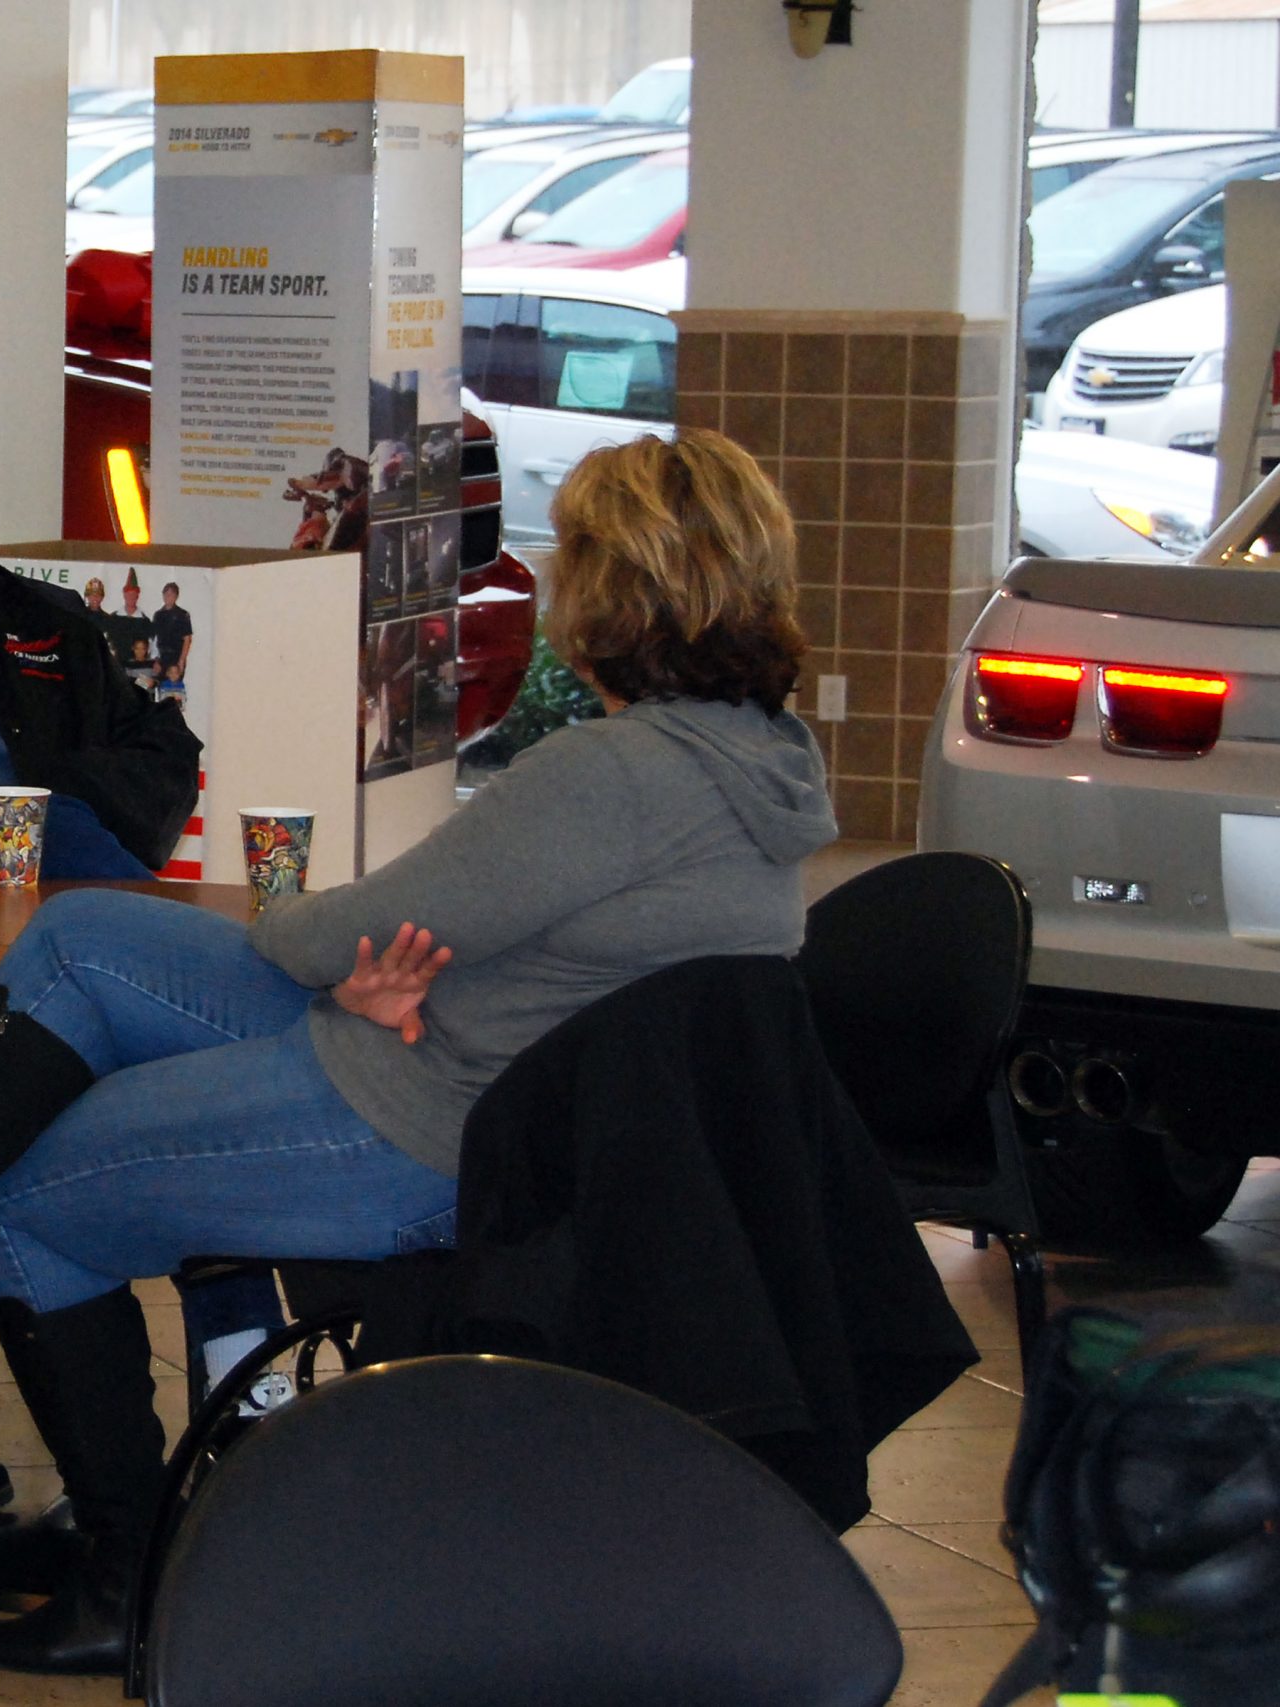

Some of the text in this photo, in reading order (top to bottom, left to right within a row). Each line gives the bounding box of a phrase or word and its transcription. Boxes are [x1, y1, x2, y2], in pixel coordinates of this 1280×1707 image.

[169, 126, 250, 140] 2014 SILVERADO
[182, 246, 269, 268] HANDLING
[182, 274, 328, 297] IS A TEAM SPORT.
[388, 299, 445, 323] THE PROOF IS IN
[387, 328, 401, 349] THE
